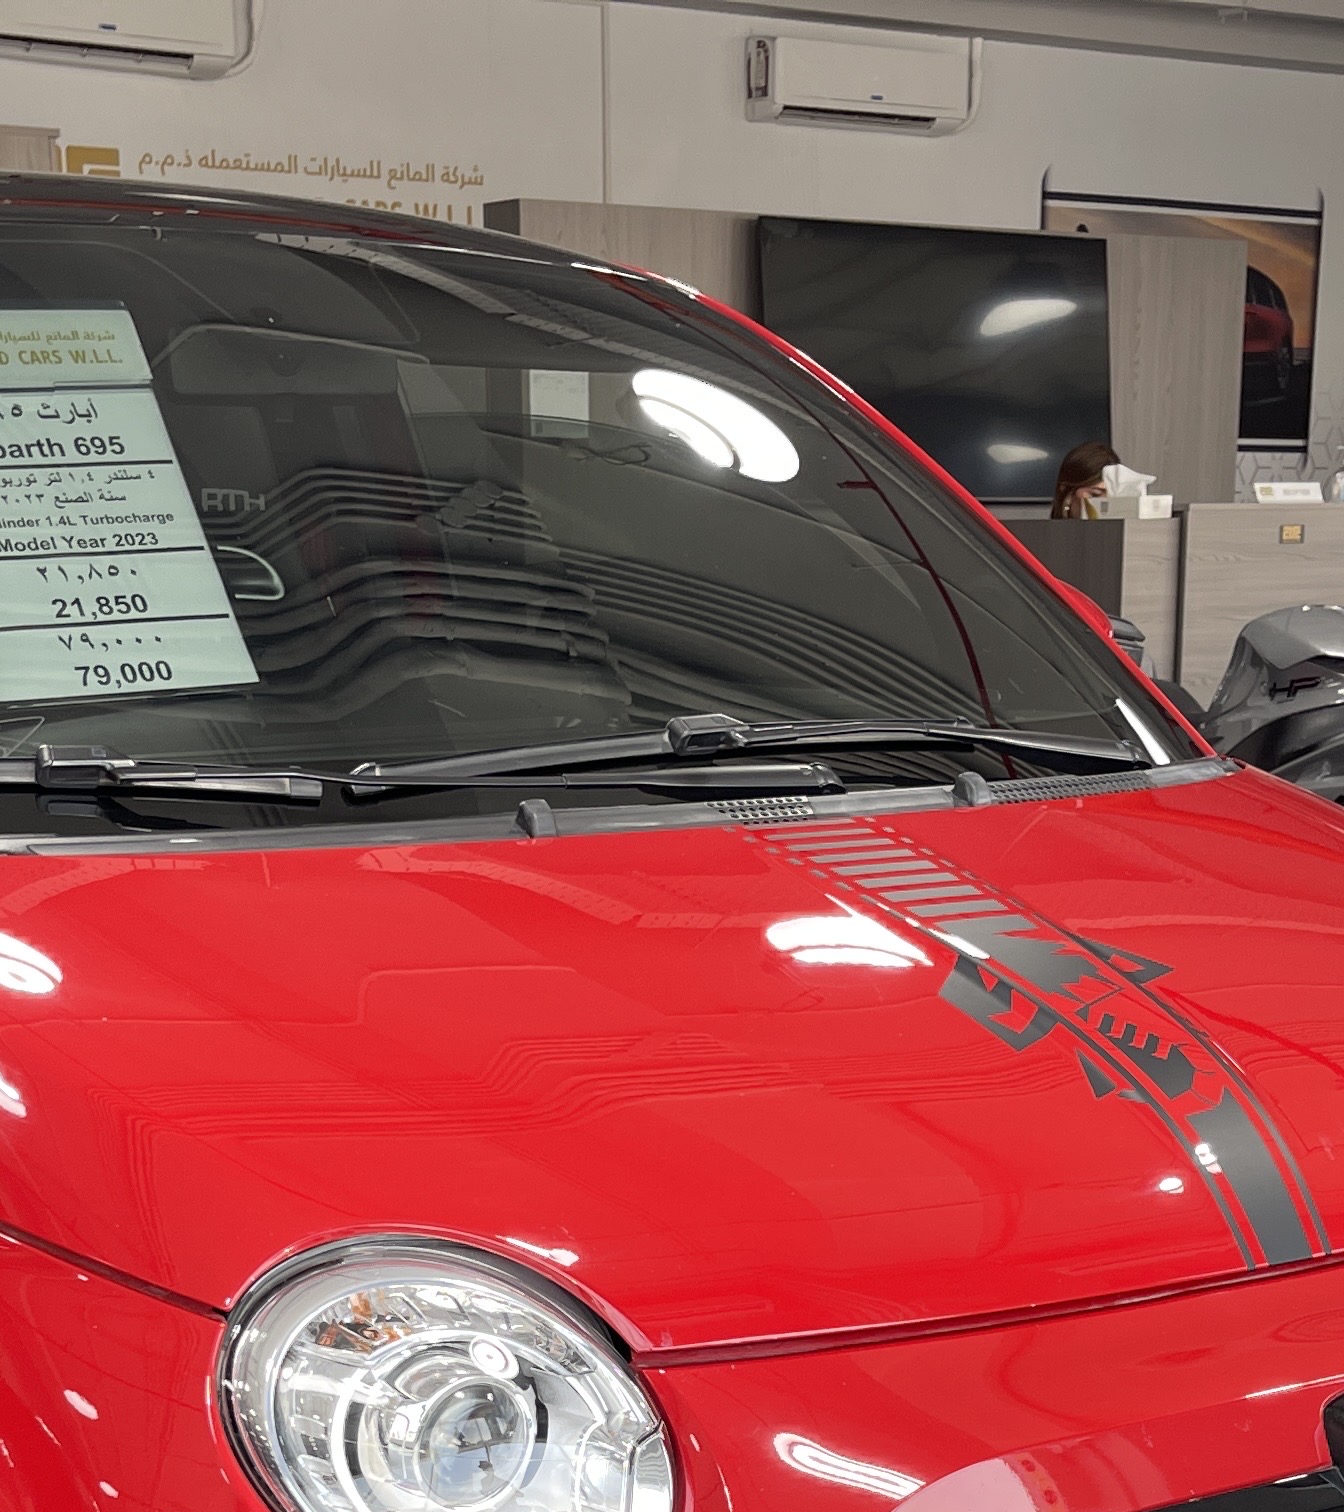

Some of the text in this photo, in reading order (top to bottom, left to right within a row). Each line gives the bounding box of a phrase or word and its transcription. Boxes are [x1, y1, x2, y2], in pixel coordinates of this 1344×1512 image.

[303, 156, 382, 183] للسيارات
[387, 161, 436, 189] المانع
[440, 164, 485, 190] شركة
[45, 329, 80, 344] المانع
[83, 331, 115, 342] شركة
[18, 350, 63, 365] CARS
[68, 349, 123, 364] W.L.L.
[36, 397, 99, 425] أبارث
[73, 435, 126, 456] 695
[44, 471, 63, 487] لتر
[147, 469, 155, 480] ٤
[0, 488, 127, 509] سنة الصنع ٢٠٢٣
[45, 515, 77, 527] 1.4L
[79, 511, 175, 527] Turbocharge
[60, 534, 108, 550] Year
[112, 532, 159, 547] 2023
[51, 593, 149, 620] 21,850
[74, 660, 173, 689] 79,000
